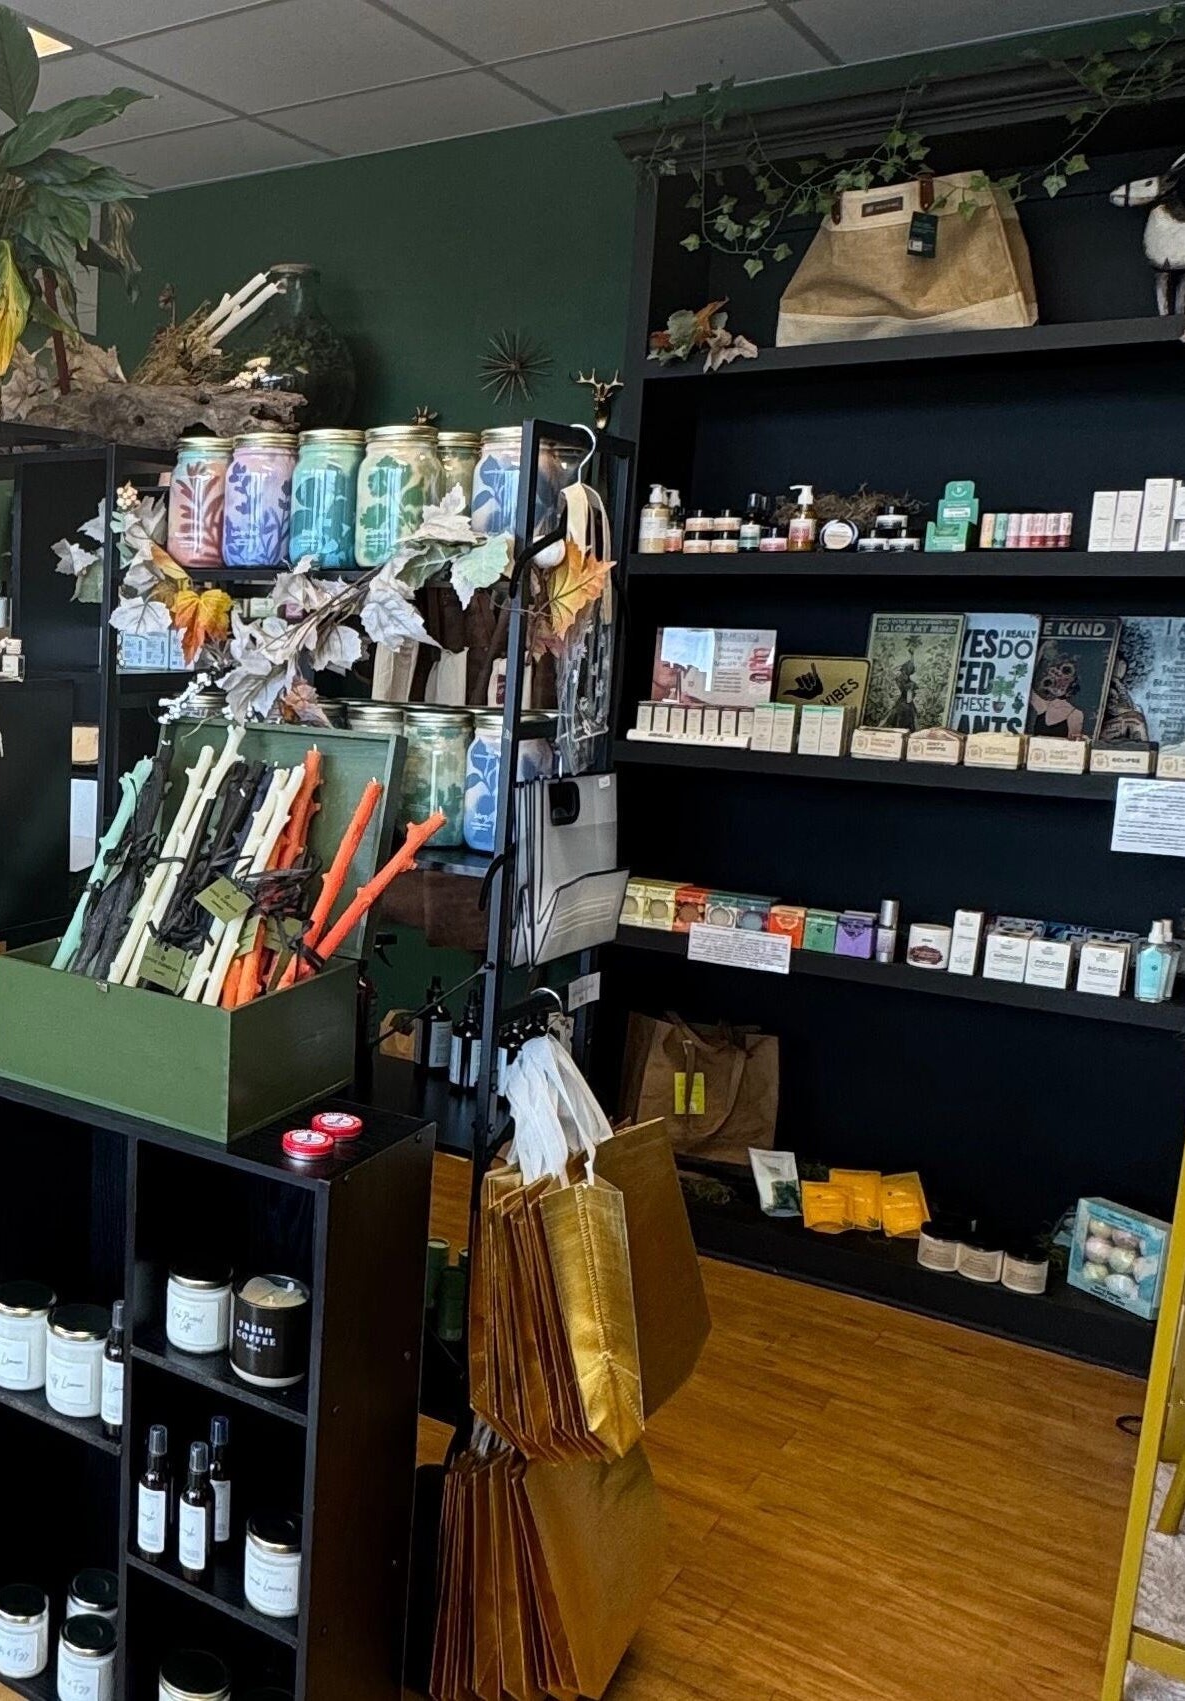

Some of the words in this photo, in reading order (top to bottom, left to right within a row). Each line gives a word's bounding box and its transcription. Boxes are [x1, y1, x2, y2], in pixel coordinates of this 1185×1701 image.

[877, 624, 890, 632] TO
[914, 625, 929, 633] MY
[1005, 630, 1037, 639] REALLY
[1042, 621, 1053, 636] E
[1058, 622, 1106, 637] KIND
[997, 639, 1034, 660] DO
[956, 661, 996, 695] EED
[820, 678, 859, 705] VIBES
[955, 696, 991, 712] THESE
[957, 714, 1023, 735] ANTS
[238, 1319, 273, 1336] FRESH
[236, 1328, 277, 1347] COFFEE
